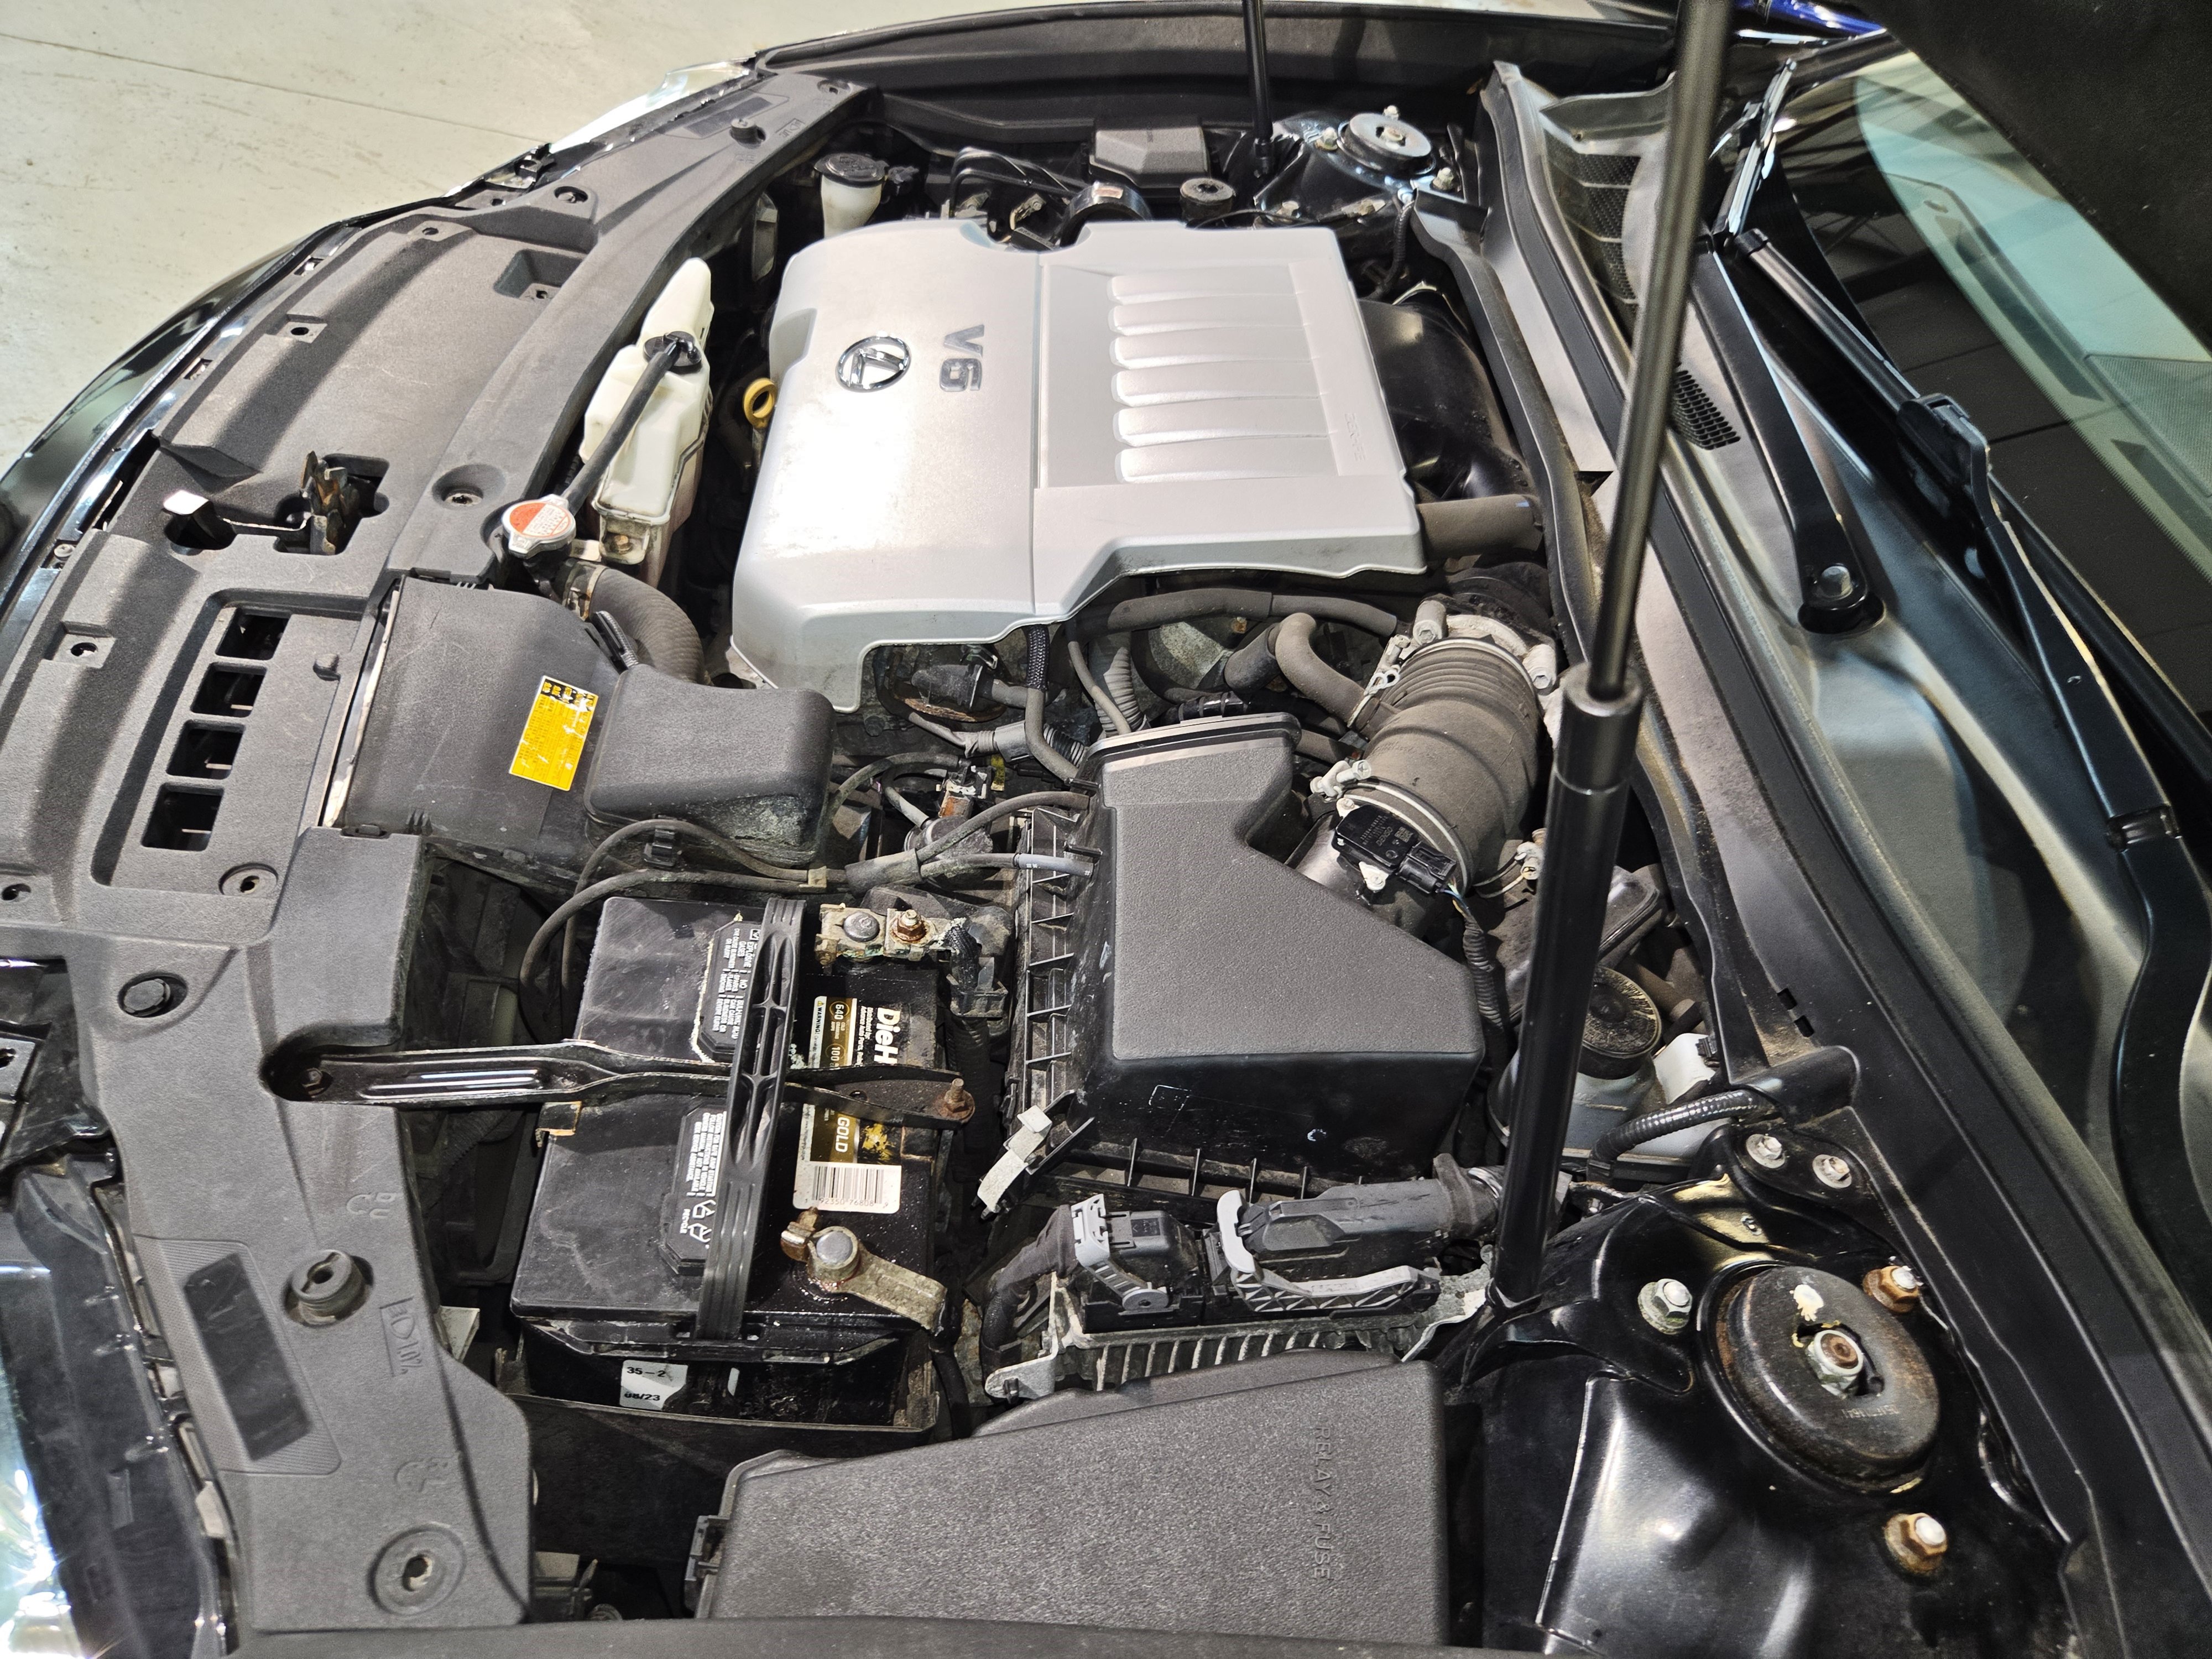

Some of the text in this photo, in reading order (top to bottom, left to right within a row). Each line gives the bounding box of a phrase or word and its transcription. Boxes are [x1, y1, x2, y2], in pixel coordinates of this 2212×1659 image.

[939, 324, 984, 392] V6
[1375, 826, 1393, 846] DENSO
[738, 941, 746, 957] GASES
[743, 941, 755, 968] EXPLOSIVE
[740, 979, 748, 989] NO
[834, 1004, 844, 1020] 640
[874, 1007, 900, 1064] DieH
[831, 1046, 841, 1061] 100
[708, 1114, 716, 1133] FOLLOW
[836, 1117, 850, 1152] GOLD
[680, 1208, 690, 1234] RECYCLE
[1314, 1426, 1333, 1579] RELAY & FUSE
